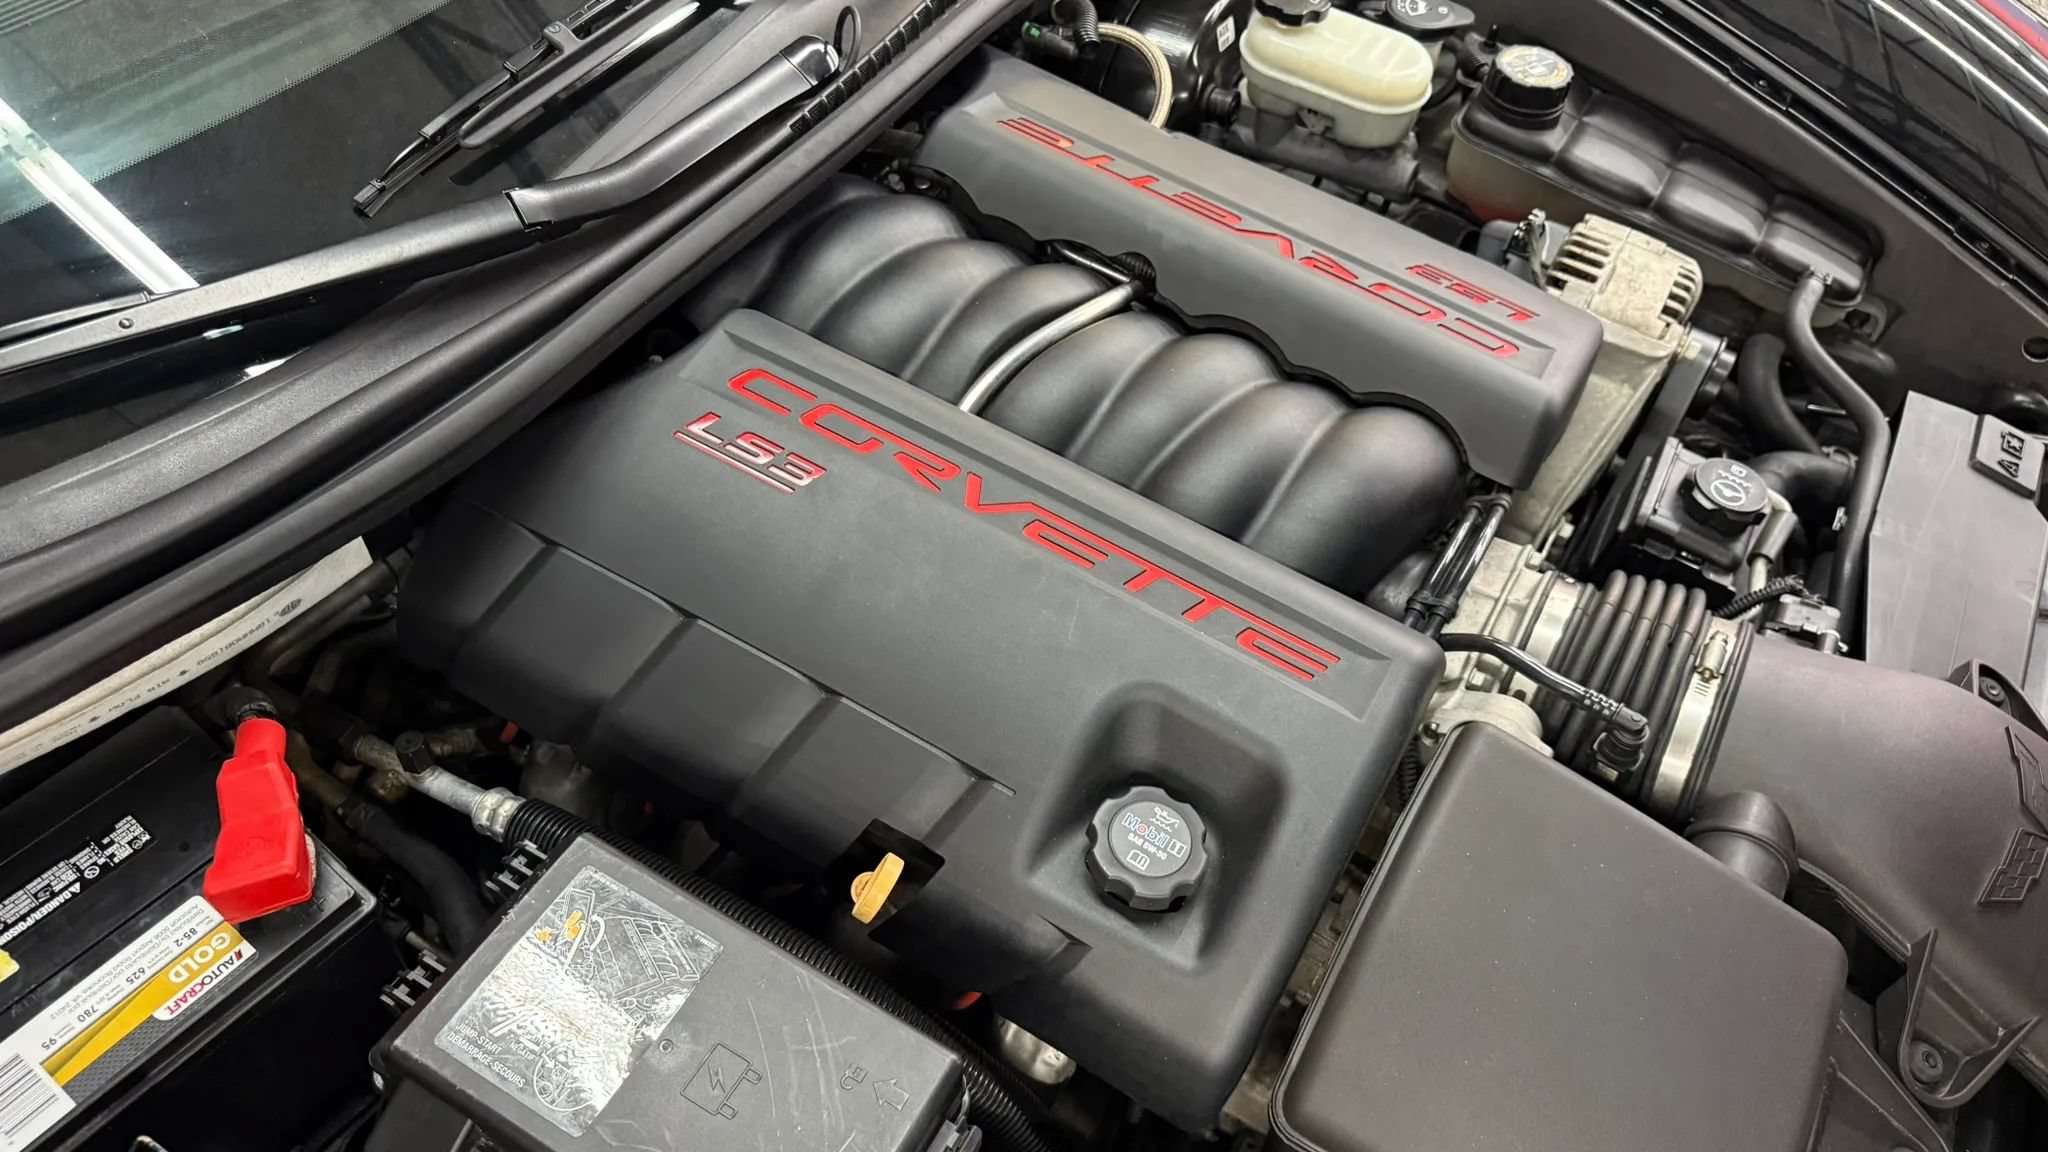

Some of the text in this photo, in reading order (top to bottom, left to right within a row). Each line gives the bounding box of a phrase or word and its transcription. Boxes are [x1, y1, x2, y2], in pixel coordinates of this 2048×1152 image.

[998, 117, 1520, 358] CORVETTE
[1407, 263, 1540, 321] LS3
[683, 411, 828, 488] LS3
[727, 368, 1341, 681] CORVETTE
[1121, 813, 1169, 848] Mobil
[1143, 841, 1167, 861] 5W-30
[168, 932, 231, 983] GOLD
[173, 927, 198, 947] 85-2
[126, 965, 147, 985] 625
[164, 957, 235, 1015] AUTOCRAFT
[77, 1006, 98, 1024] 780
[41, 1037, 57, 1051] 95
[446, 1031, 526, 1088] DEMARRAGE-SECOURS
[456, 1023, 503, 1055] JUMP-START
